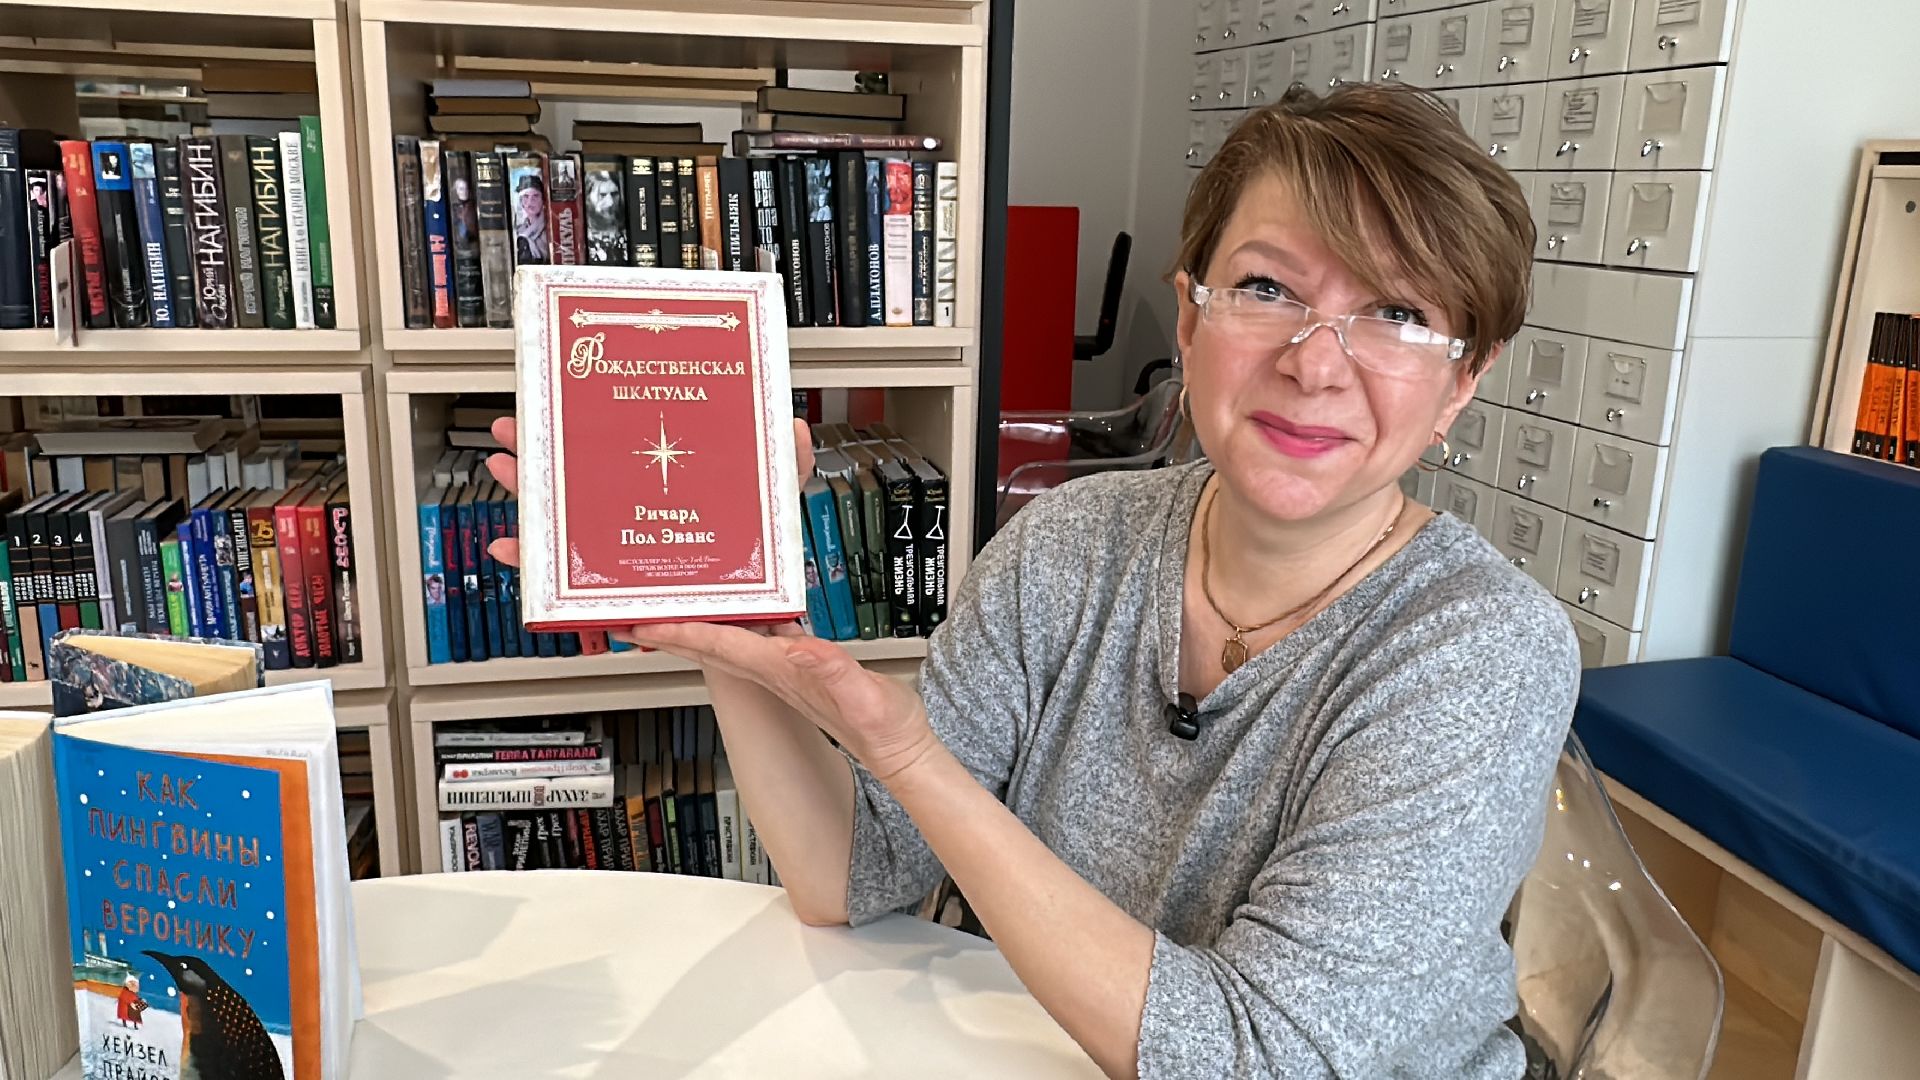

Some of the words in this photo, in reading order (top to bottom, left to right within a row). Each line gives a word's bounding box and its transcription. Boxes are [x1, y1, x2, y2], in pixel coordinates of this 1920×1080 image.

[187, 145, 225, 266] НАГИБИН
[251, 146, 286, 268] НАГИБИН
[289, 187, 306, 228] СТАРОЙ
[728, 193, 743, 256] ПИЛЬНЯК
[146, 242, 168, 301] НАГИБИН
[154, 304, 171, 322] Ю.
[612, 385, 708, 401] ШКАТУЛКА
[633, 505, 701, 524] Ричард
[14, 536, 21, 547] 1
[32, 534, 42, 545] 2
[54, 535, 63, 546] 3
[74, 532, 84, 543] 4
[620, 528, 657, 546] Пол
[659, 527, 717, 545] Эванс
[893, 556, 904, 596] ЖИЗНЬ
[904, 543, 916, 606] ТРЕУГОЛЬНАЯ
[924, 557, 936, 597] ЖИЗНЬ
[935, 543, 946, 607] ТРЕУГОЛЬНАЯ
[495, 750, 530, 761] TERRA
[135, 768, 200, 811] КАК
[447, 790, 532, 806] ПРИЛЕПИН
[546, 789, 589, 803] ЗАХАР
[87, 805, 260, 867] ПИНГВИНЫ
[112, 860, 238, 911] СПАСЛИ
[101, 898, 256, 960] ВЕРОНИКУ
[102, 1033, 168, 1067] ХЕЙЗЕЛ
